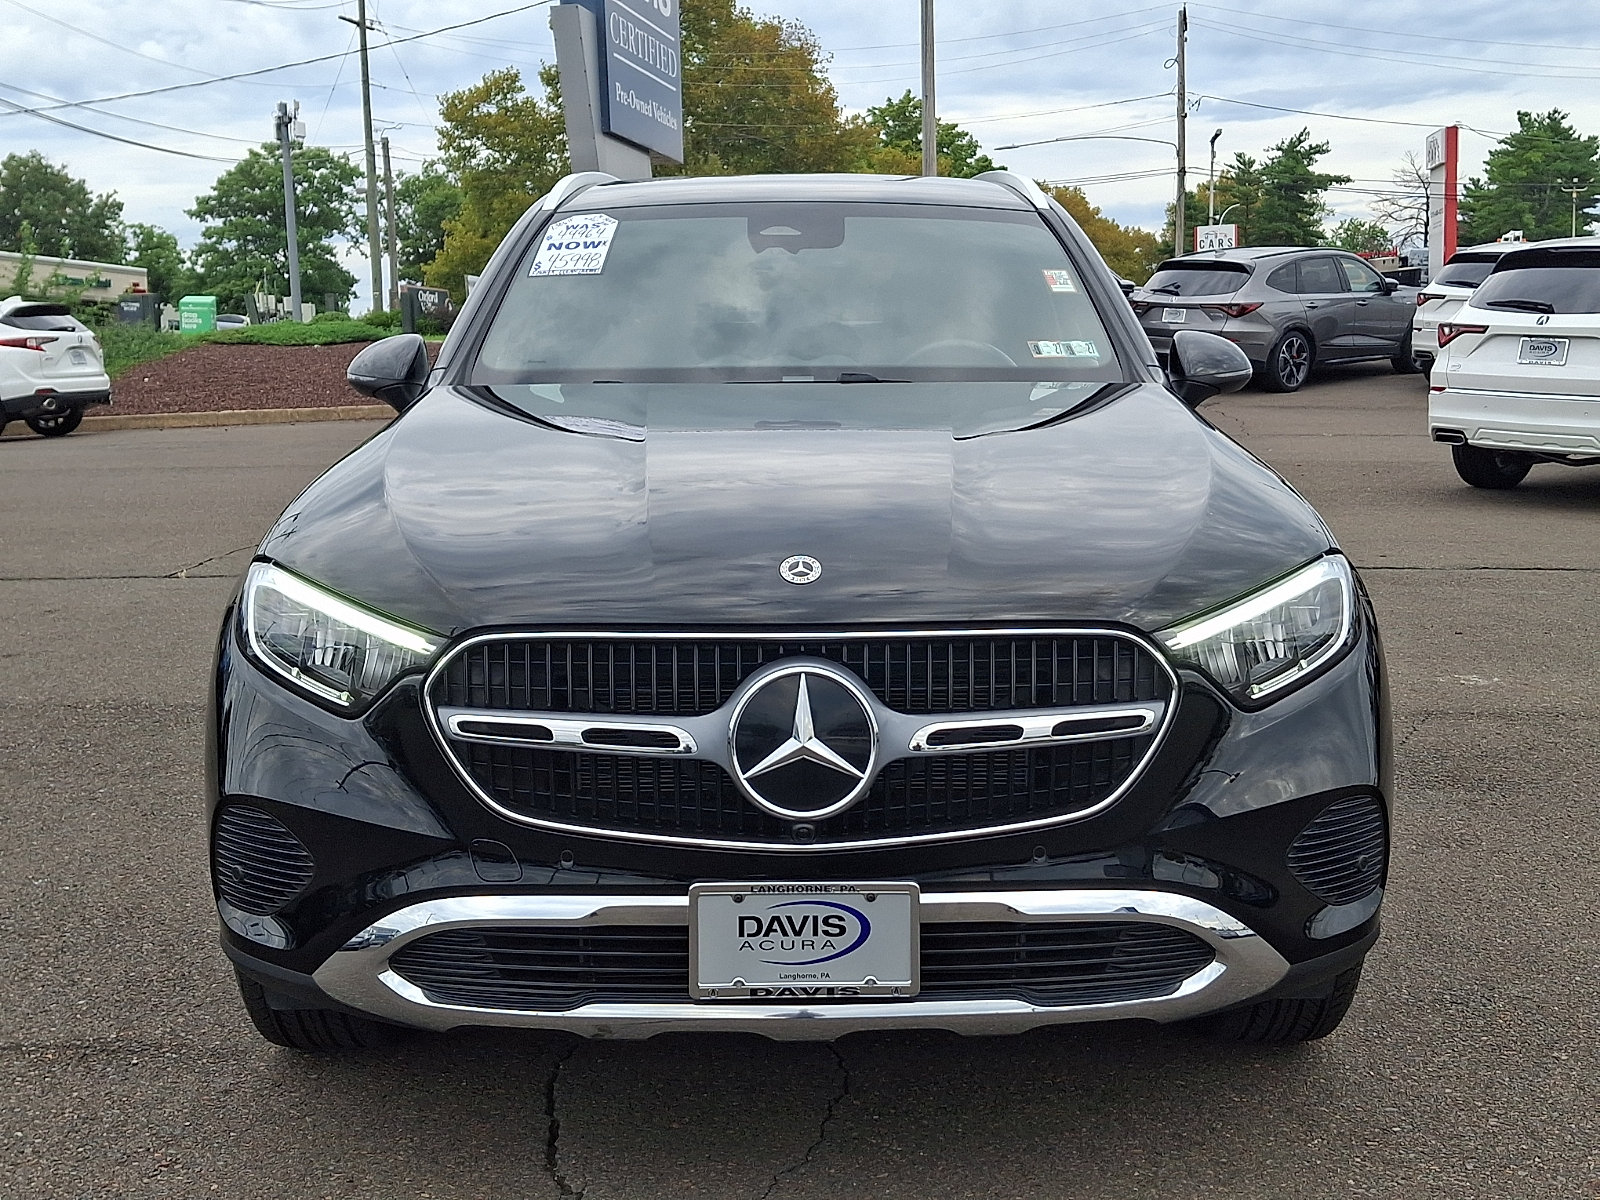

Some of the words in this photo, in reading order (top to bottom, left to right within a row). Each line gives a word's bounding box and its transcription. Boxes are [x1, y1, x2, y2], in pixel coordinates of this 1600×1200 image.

[609, 11, 677, 78] CERTIFIED
[615, 82, 651, 117] Pre-Owned
[652, 99, 678, 130] Vehicles
[565, 222, 601, 231] WAS
[547, 241, 602, 251] NOW
[1199, 237, 1233, 249] CARS
[1529, 344, 1553, 352] DAVIS
[737, 914, 847, 938] DAVIS
[738, 939, 837, 951] ACURA
[779, 972, 819, 980] Langhorne,
[820, 972, 831, 980] PA
[749, 986, 861, 996] DAVIS
